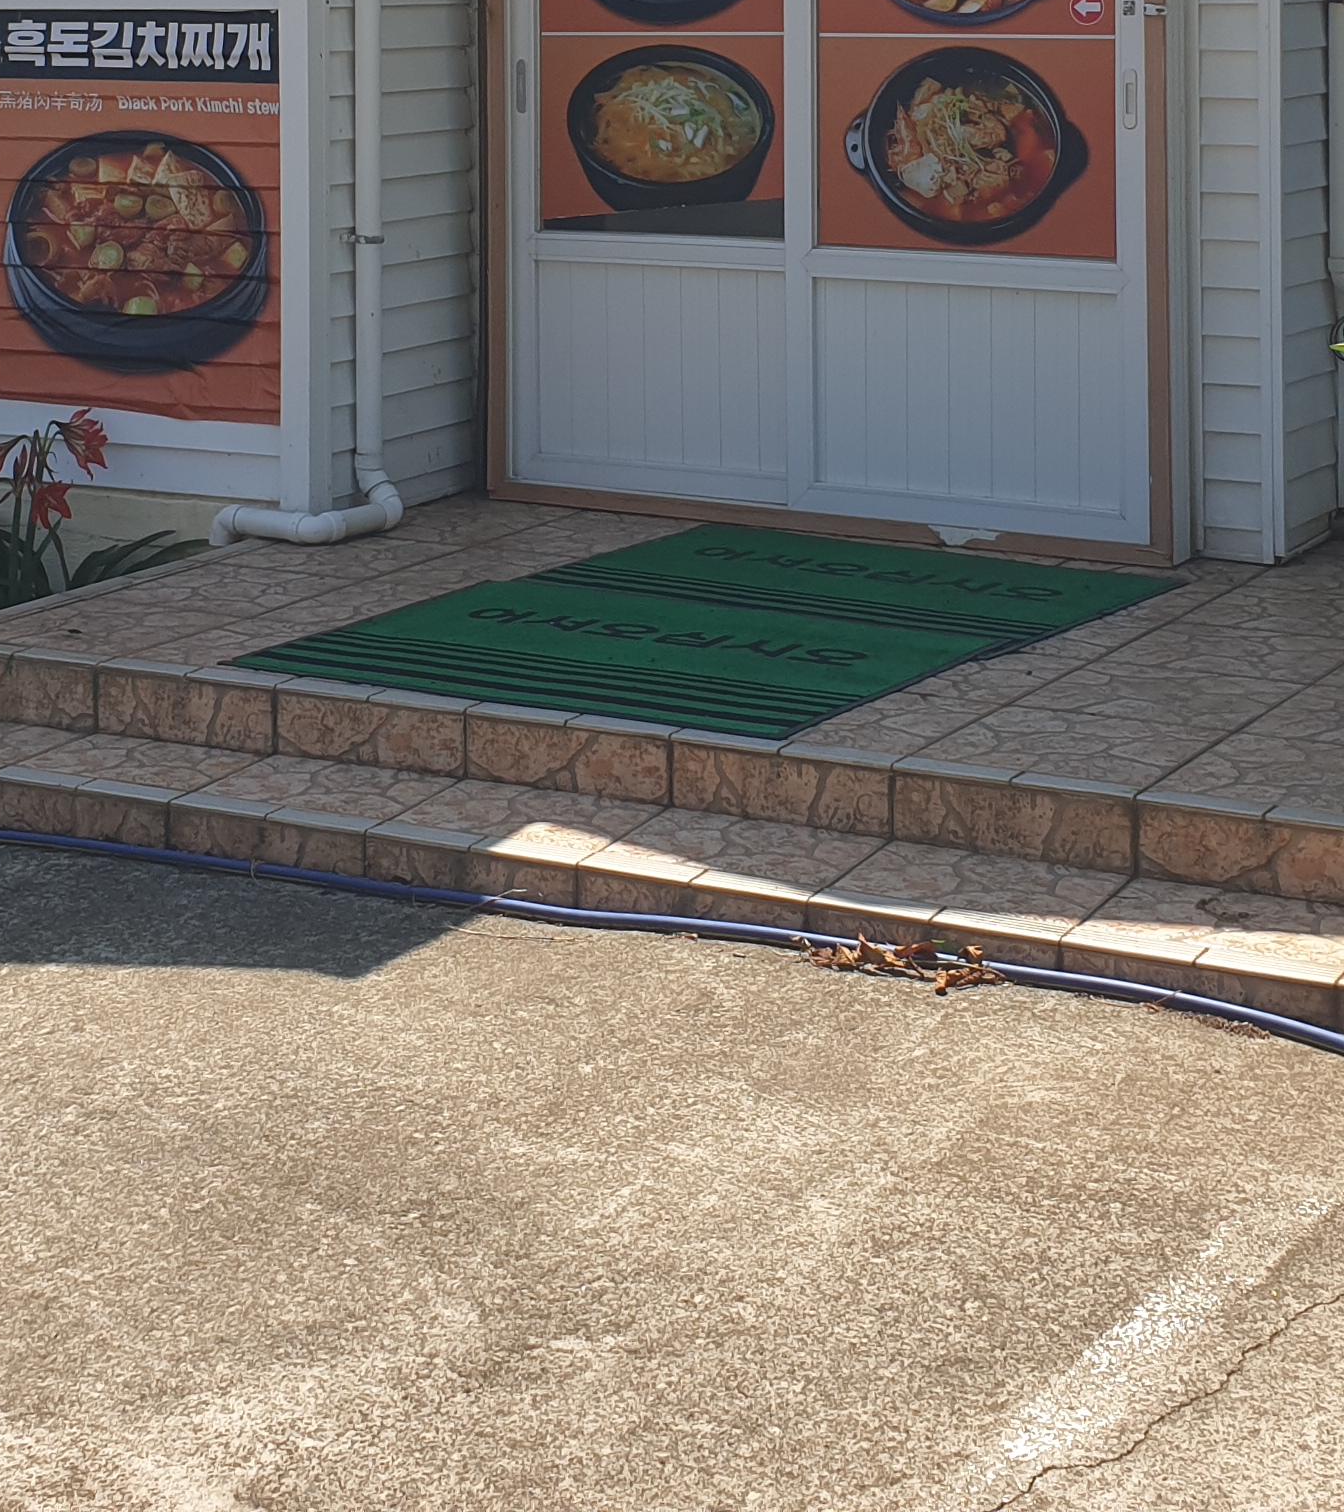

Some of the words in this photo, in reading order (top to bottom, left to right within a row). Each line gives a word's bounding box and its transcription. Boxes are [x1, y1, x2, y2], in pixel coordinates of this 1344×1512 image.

[4, 19, 272, 71] 흑돈김치찌개
[117, 95, 158, 111] Black
[161, 96, 193, 112] Pork
[197, 97, 243, 114] Kimchi
[247, 100, 280, 116] stew
[467, 606, 870, 668] 어서오십시오
